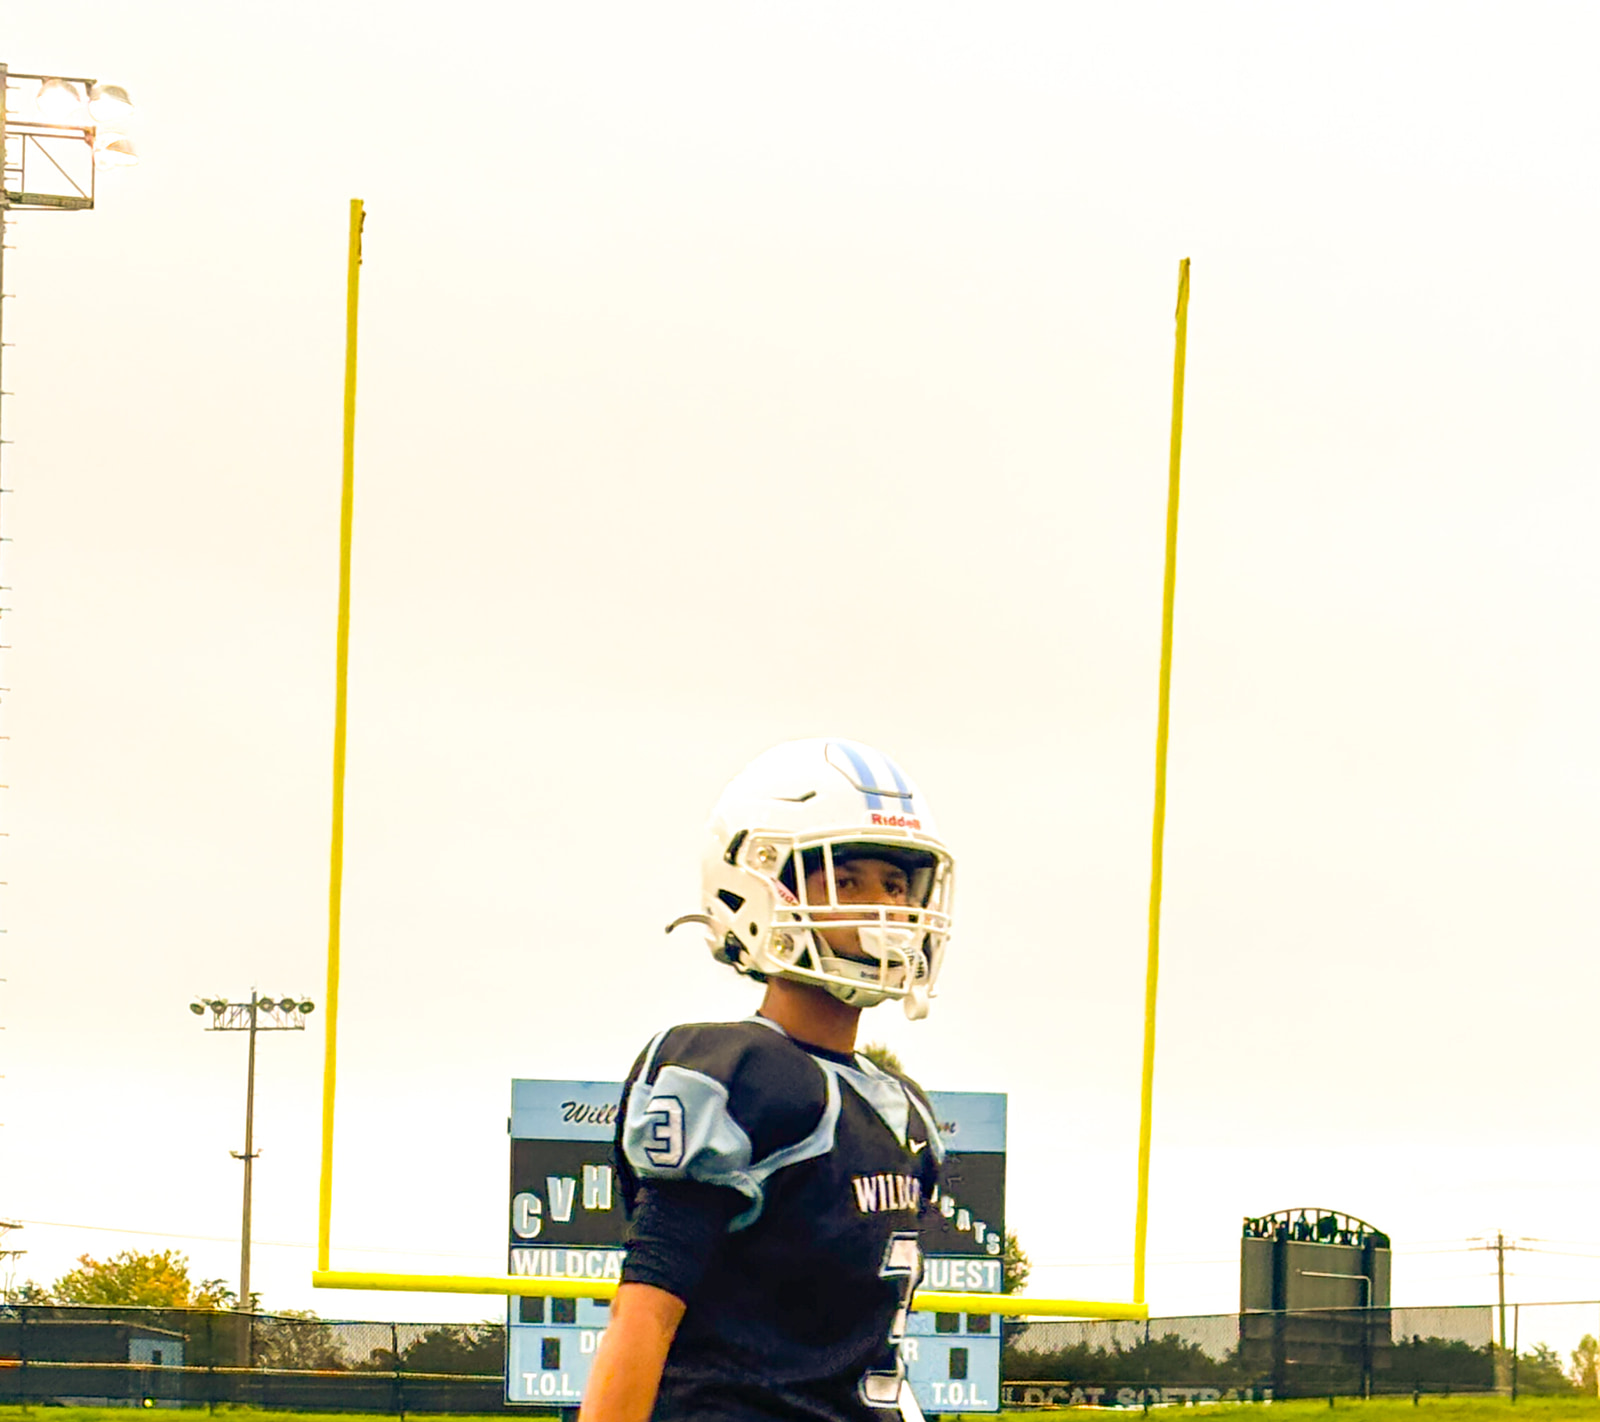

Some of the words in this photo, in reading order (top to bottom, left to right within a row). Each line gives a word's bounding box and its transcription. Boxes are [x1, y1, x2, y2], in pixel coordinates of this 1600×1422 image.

[644, 1095, 685, 1168] 3
[522, 1373, 581, 1396] T.O.L.
[932, 1382, 988, 1405] T.O.L.
